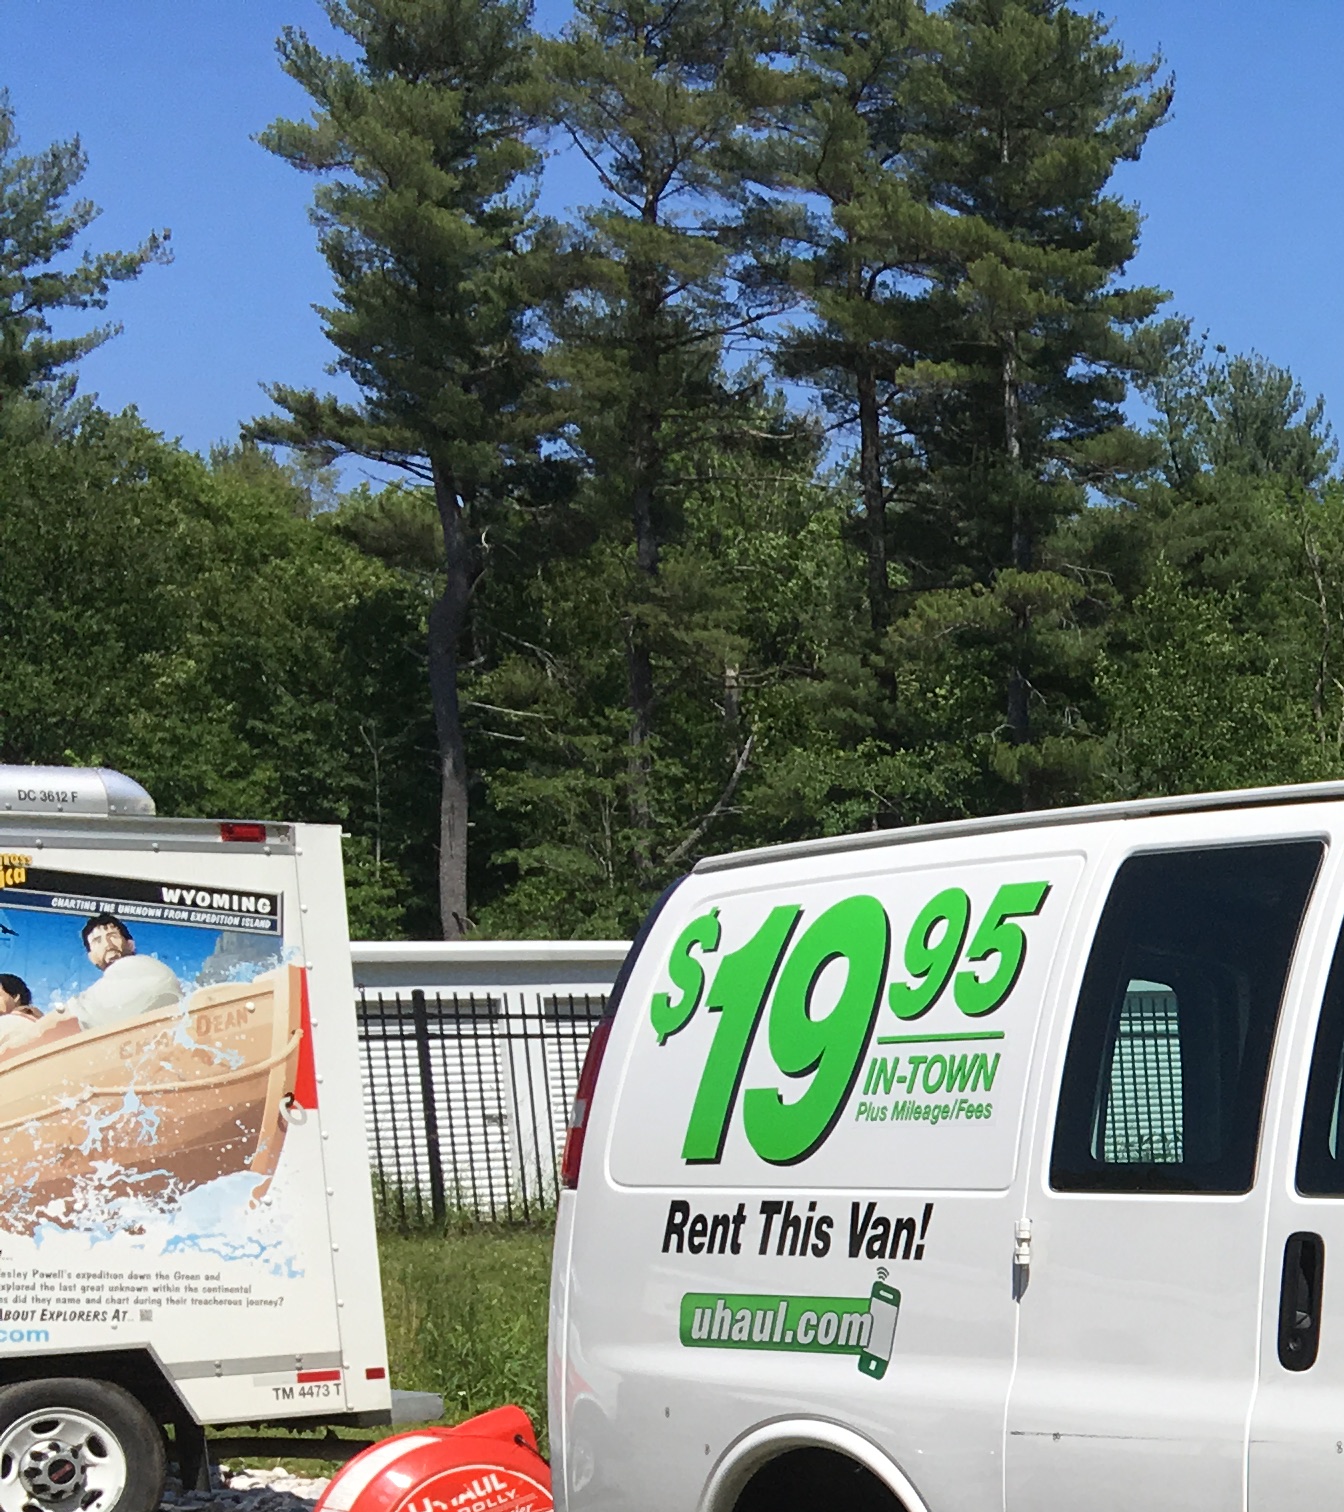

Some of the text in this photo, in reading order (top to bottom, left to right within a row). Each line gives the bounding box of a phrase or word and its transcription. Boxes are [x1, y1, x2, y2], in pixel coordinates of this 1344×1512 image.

[17, 789, 78, 803] DC 3612 F
[161, 886, 272, 914] WYOMING
[51, 897, 272, 929] CHARTING THE UNKNOWN FROM EXPEDITION ISLAND
[862, 1053, 1001, 1095] IN-TOWN
[855, 1099, 993, 1125] Plus Mileage/Fees
[661, 1199, 934, 1261] Rent This Van!
[0, 1269, 28, 1280] esley
[76, 1270, 124, 1281] expedition
[127, 1270, 151, 1280] down
[155, 1271, 170, 1280] the
[173, 1271, 200, 1280] Green
[204, 1272, 220, 1281] and
[40, 1283, 55, 1292] the
[59, 1282, 76, 1292] last
[81, 1283, 104, 1294] great
[108, 1283, 148, 1293] unknown
[152, 1284, 180, 1293] within
[184, 1284, 198, 1293] the
[202, 1284, 252, 1294] continental
[12, 1295, 27, 1304] did
[31, 1295, 52, 1306] they
[55, 1297, 81, 1305] name
[85, 1295, 101, 1304] and
[105, 1295, 129, 1305] chart
[133, 1296, 162, 1308] during
[166, 1296, 187, 1306] their
[191, 1296, 242, 1306] treacherous
[246, 1296, 284, 1308] journey?
[40, 1308, 108, 1322] EXPLORERS
[691, 1299, 873, 1347] uhaul.com
[272, 1383, 341, 1401] TM 4473 T
